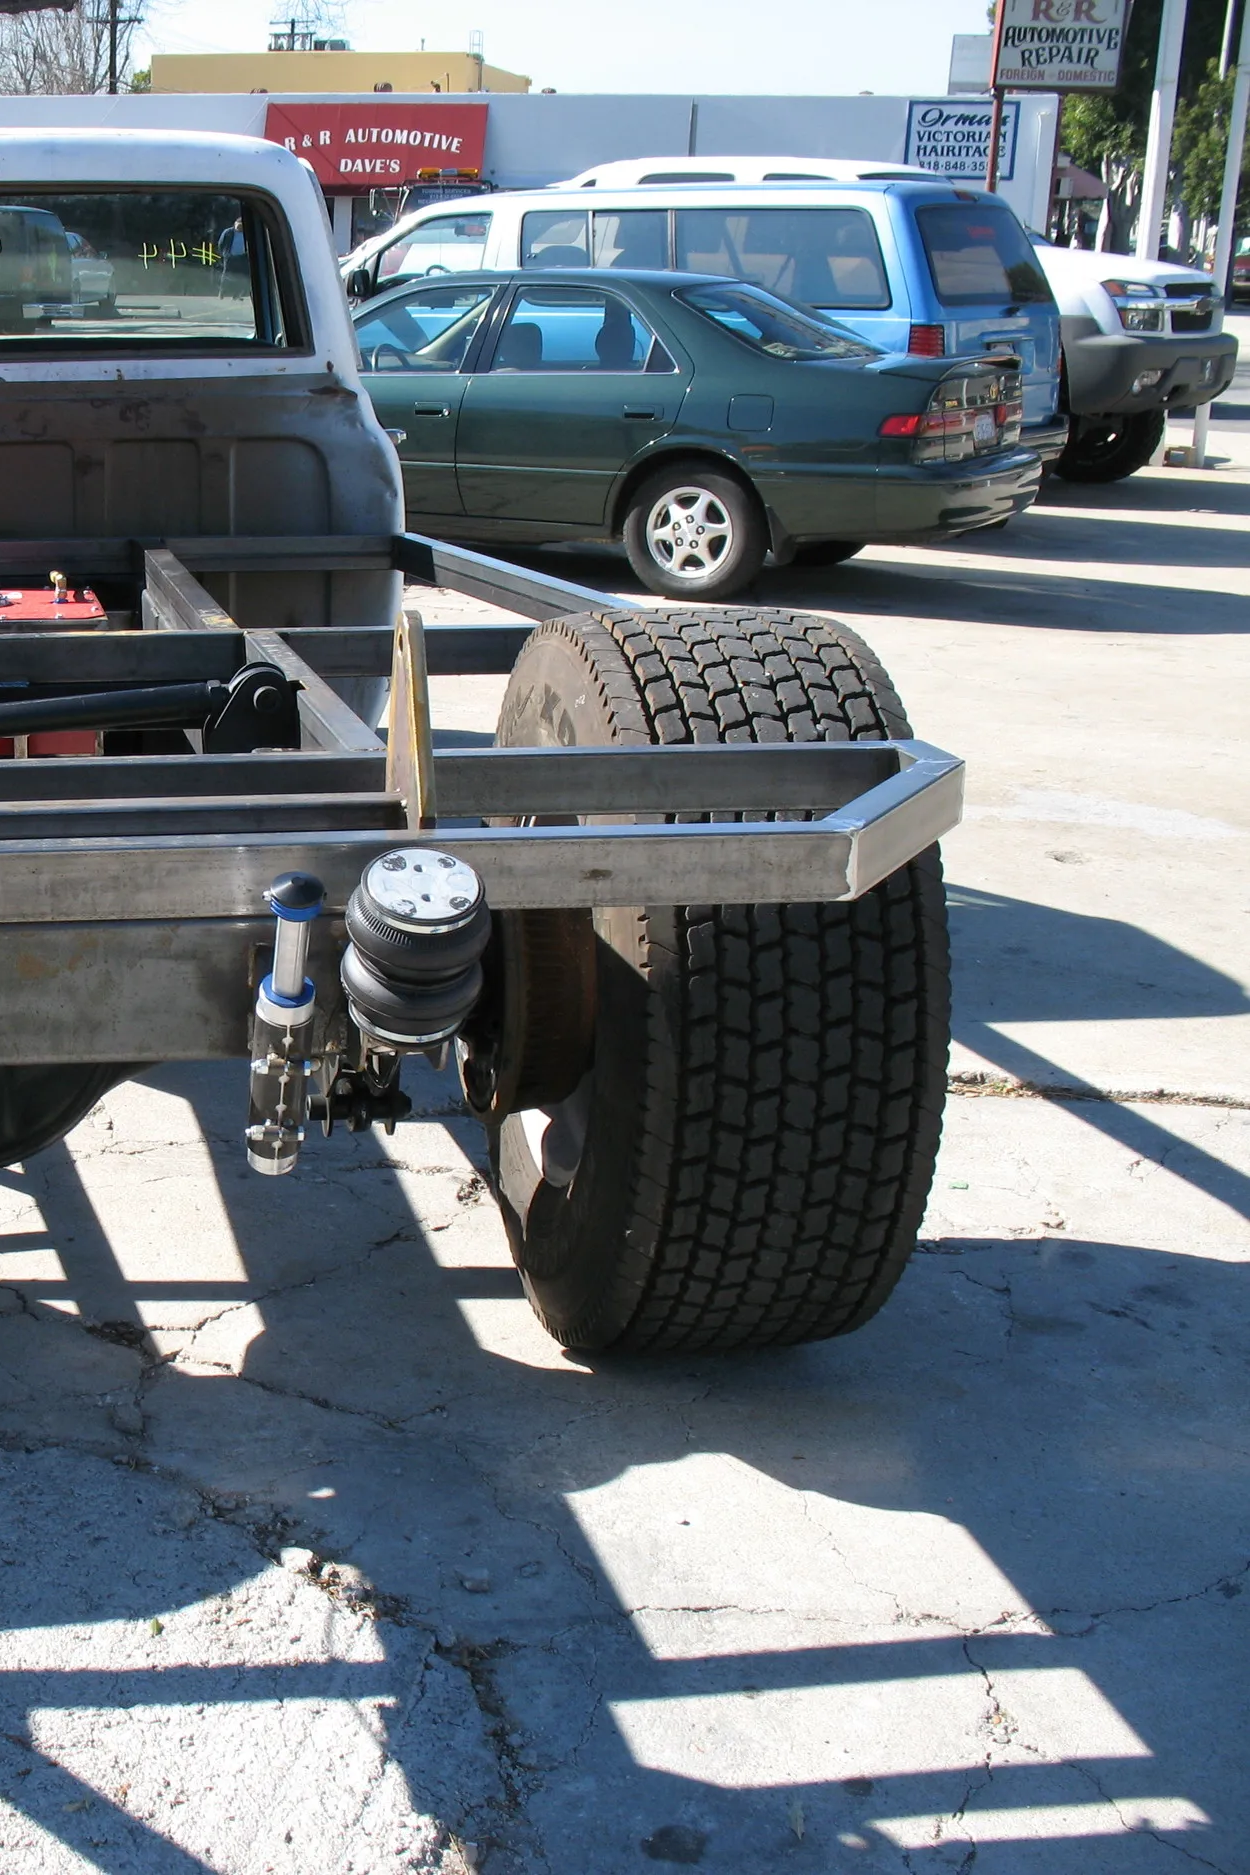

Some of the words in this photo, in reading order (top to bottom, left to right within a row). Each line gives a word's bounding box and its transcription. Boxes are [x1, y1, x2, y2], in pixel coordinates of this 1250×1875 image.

[1003, 26, 1119, 50] AUTOMOTIVE
[1020, 45, 1100, 69] REPAIR
[999, 68, 1045, 81] FOREIGN
[1057, 69, 1116, 82] DOMESTIC
[319, 130, 331, 145] R
[345, 128, 463, 153] AUTOMOTIVE
[339, 159, 401, 173] DAVE'S
